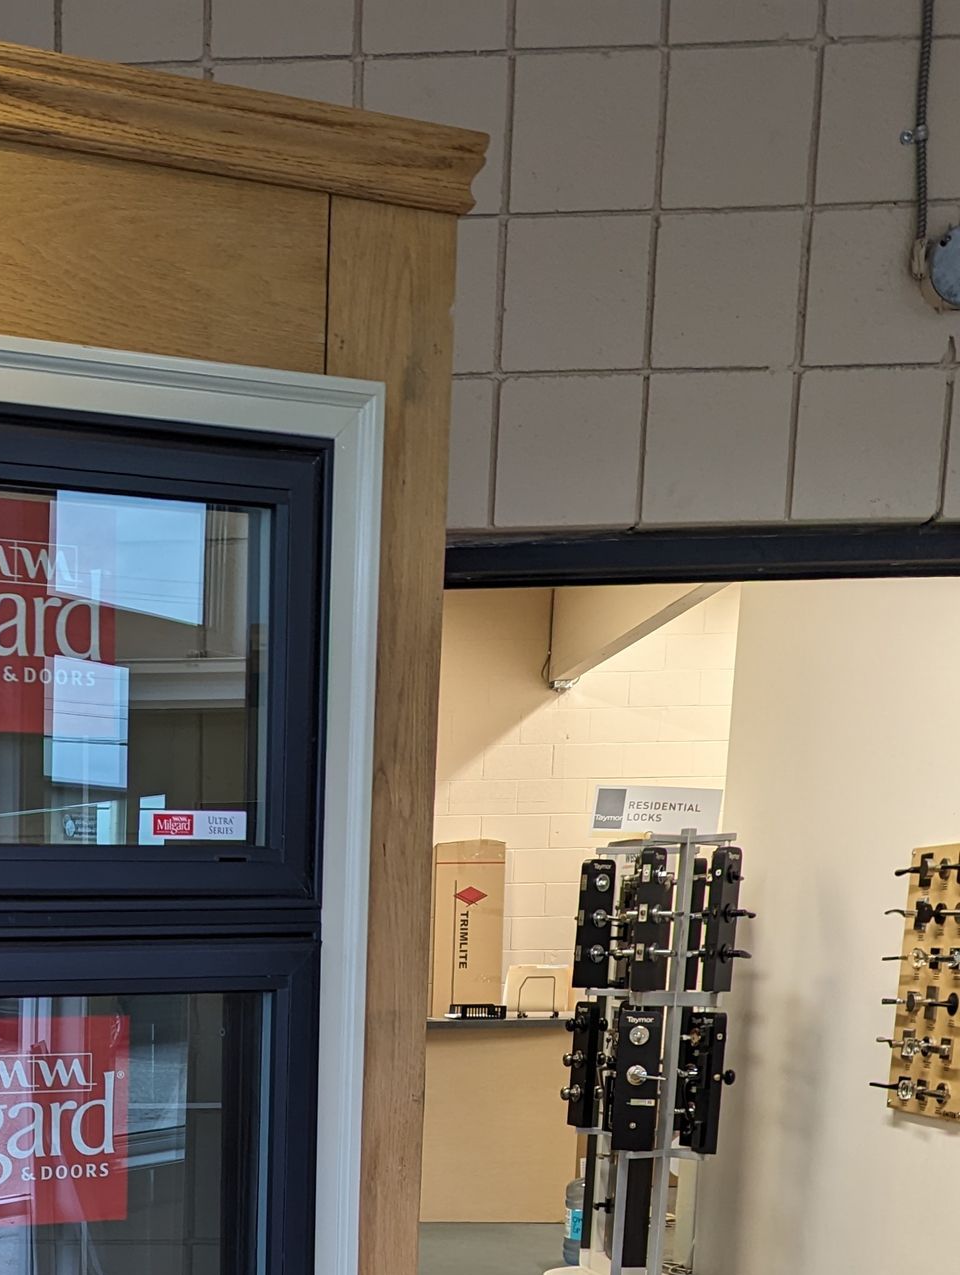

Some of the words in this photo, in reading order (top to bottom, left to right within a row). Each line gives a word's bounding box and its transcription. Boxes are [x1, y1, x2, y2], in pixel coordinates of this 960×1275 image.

[2, 665, 19, 683] &
[23, 667, 96, 686] DOORS
[628, 801, 701, 813] RESIDENTIAL
[626, 813, 663, 822] LOCKS
[156, 818, 191, 835] Milgard
[458, 911, 469, 969] TRIMLITE
[626, 1016, 655, 1024] Taymor
[20, 1167, 36, 1182] &
[41, 1163, 110, 1182] DOORS
